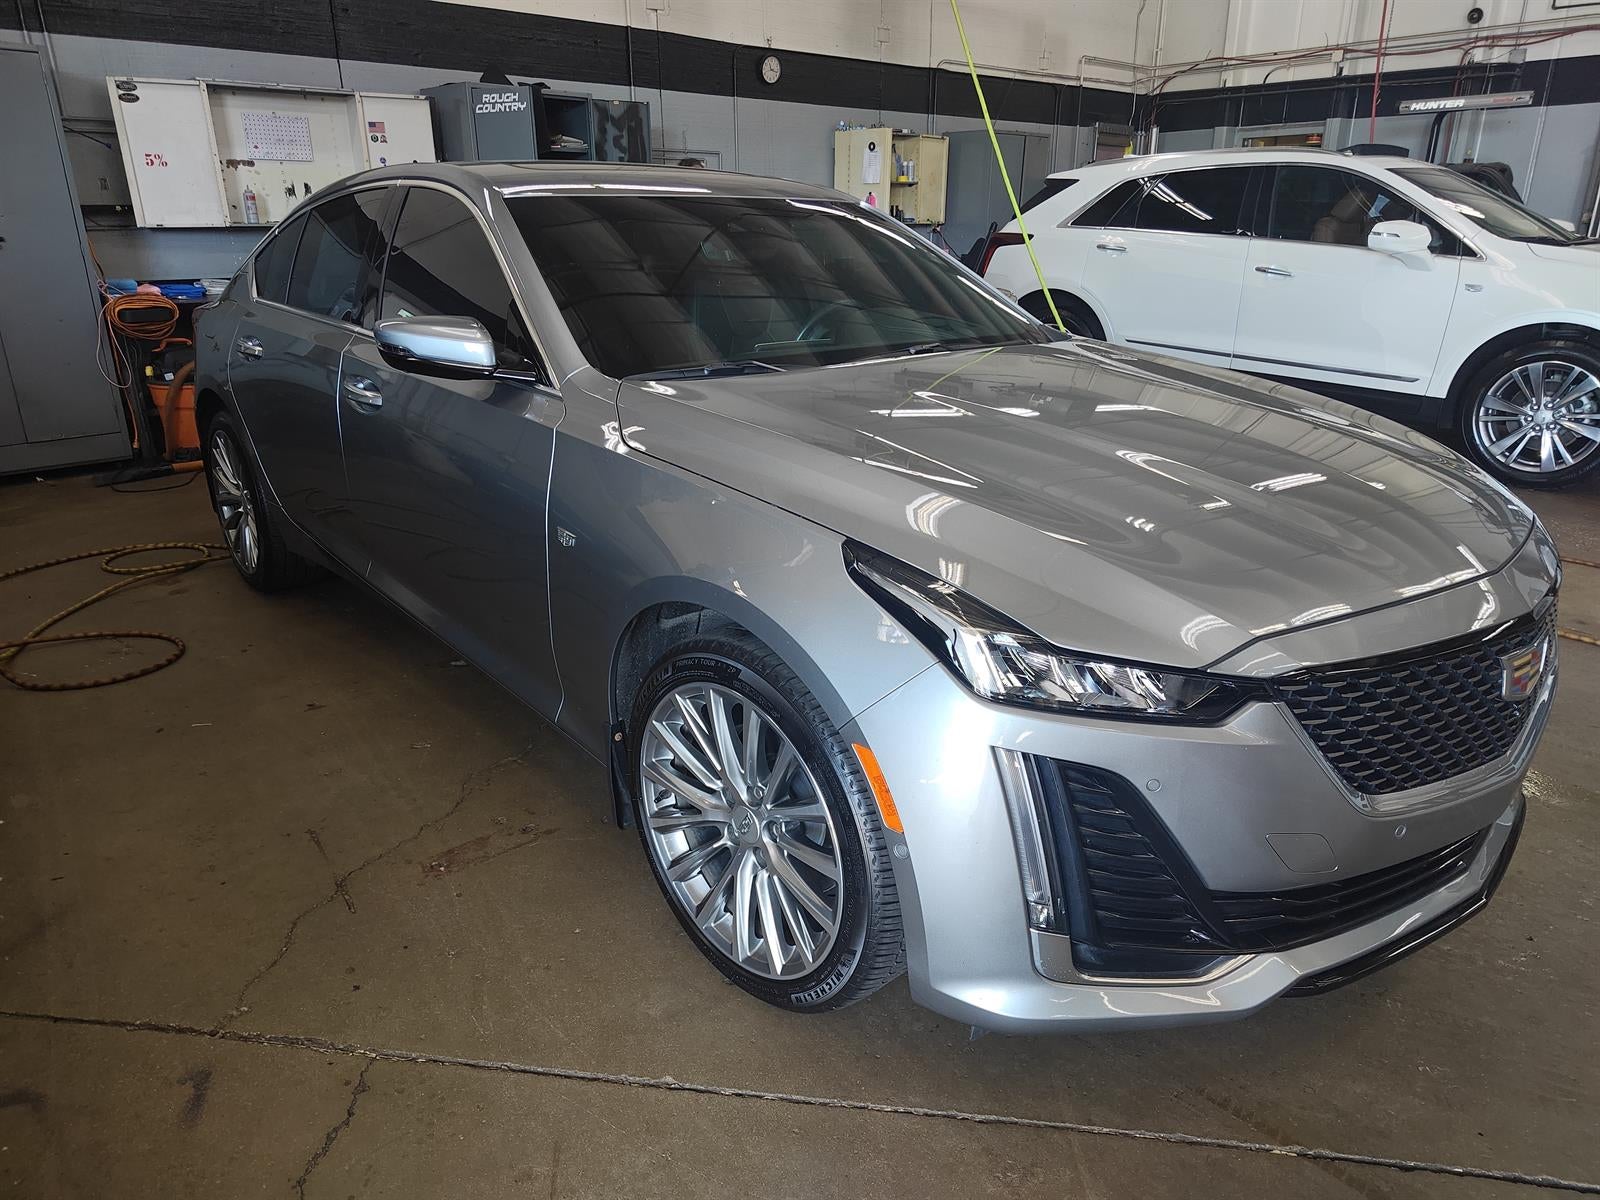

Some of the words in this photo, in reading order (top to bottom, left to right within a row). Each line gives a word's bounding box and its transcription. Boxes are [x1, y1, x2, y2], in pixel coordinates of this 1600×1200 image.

[482, 92, 519, 103] ROUGH
[475, 101, 527, 114] COUNTRY
[1410, 99, 1465, 111] HUNTER
[144, 153, 168, 168] 5%
[794, 968, 844, 1004] MICHELIN
